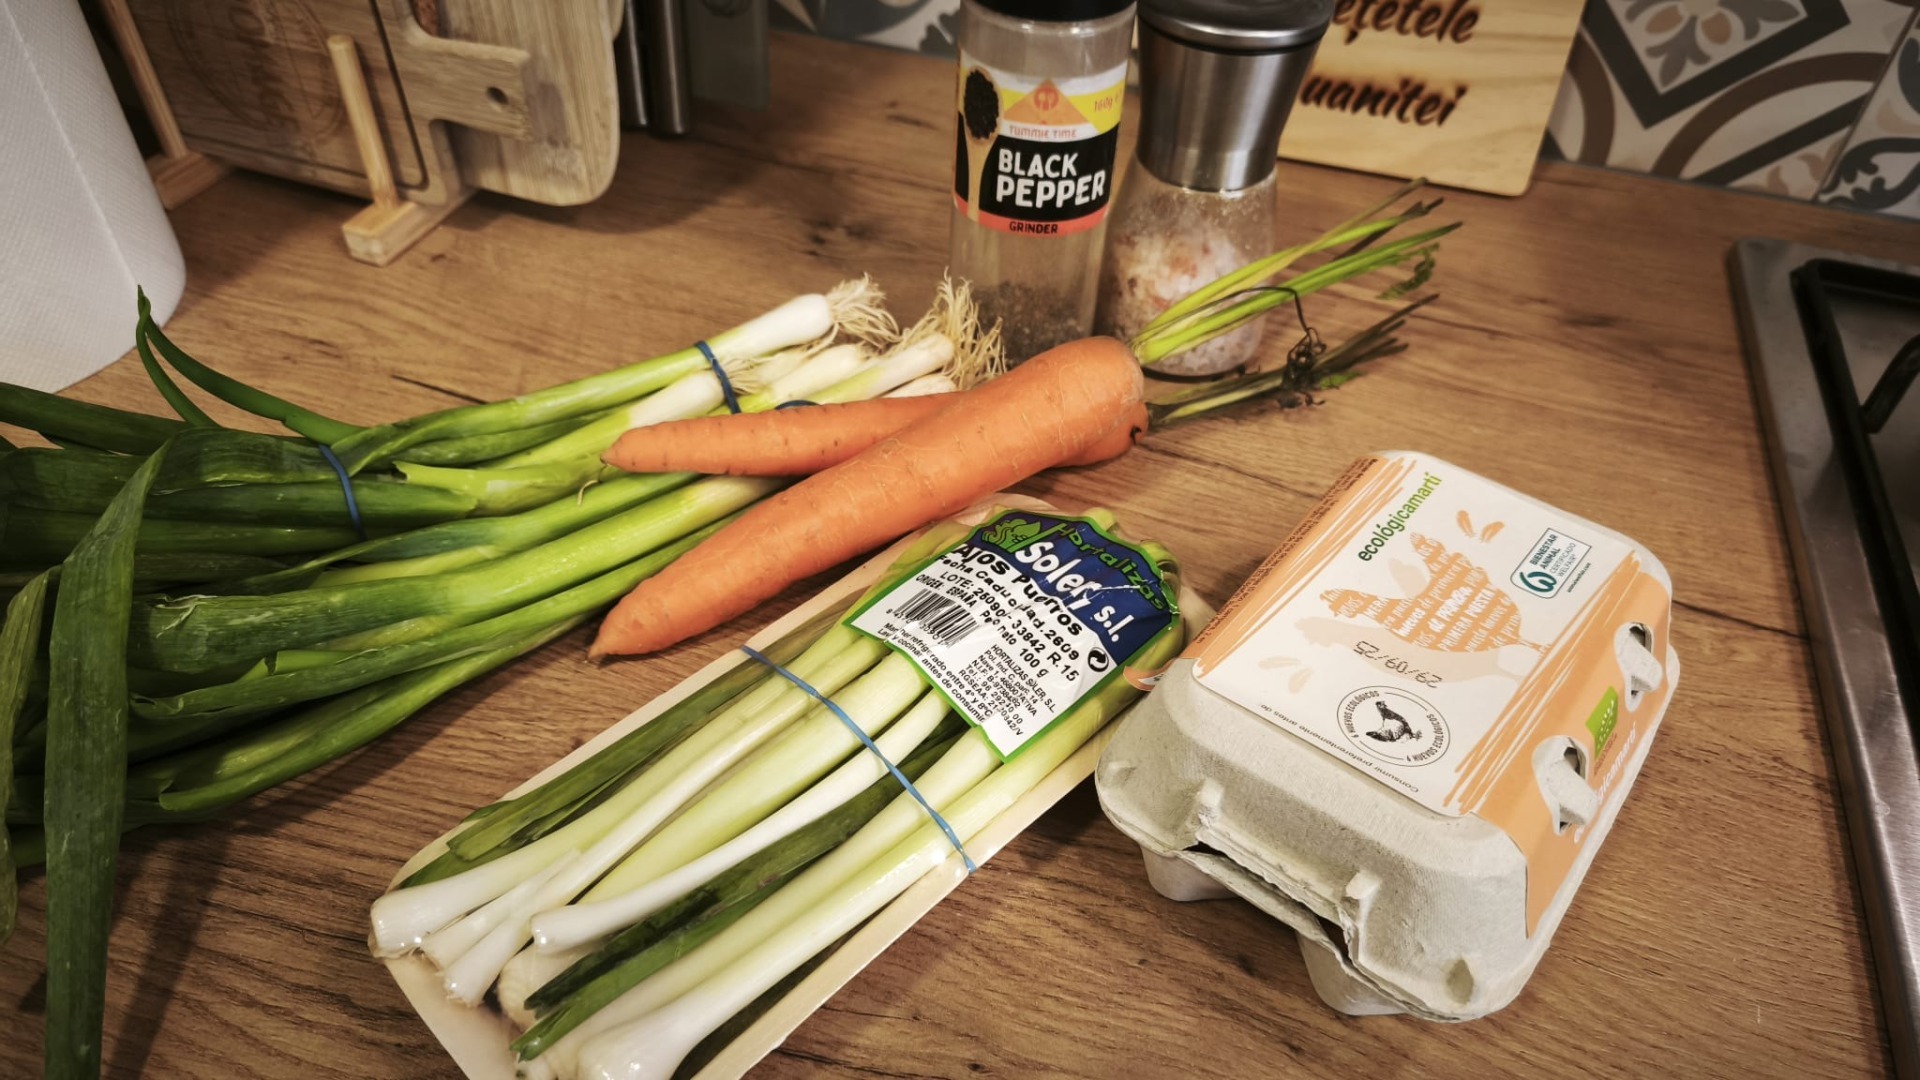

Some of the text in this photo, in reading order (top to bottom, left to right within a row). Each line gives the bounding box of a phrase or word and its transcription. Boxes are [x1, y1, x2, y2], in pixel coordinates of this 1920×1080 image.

[1009, 125, 1077, 138] TUMMIE TIME
[998, 148, 1079, 178] BLACK
[996, 169, 1106, 209] PEPPER
[1009, 221, 1058, 234] GRINDER
[1358, 472, 1442, 561] ecológicamartí
[1529, 534, 1558, 565] BIENESTAR
[1540, 548, 1561, 569] ANIMAL
[940, 555, 974, 575] Fecha
[1057, 522, 1168, 610] Hortalizas
[940, 571, 974, 590] LOTE:
[952, 543, 1082, 636] Ajos Puerros
[946, 586, 977, 608] ESPAÑA
[981, 610, 1001, 625] Peo
[1020, 648, 1041, 668] 100
[1036, 668, 1050, 678] g
[1391, 608, 1426, 637] huevos
[1437, 616, 1474, 653] PRIMERA
[1464, 588, 1497, 619] PUESTA
[921, 657, 942, 679] antes
[941, 678, 953, 690] de
[978, 655, 995, 672] Nave
[991, 644, 1029, 681] HORTALIZAS
[946, 671, 965, 690] entre
[958, 670, 988, 701] RGSEAA:
[1029, 694, 1038, 704] 14
[1012, 713, 1024, 724] 00
[1343, 711, 1356, 733] HUEVOS
[1412, 746, 1438, 762] HUEVOS
